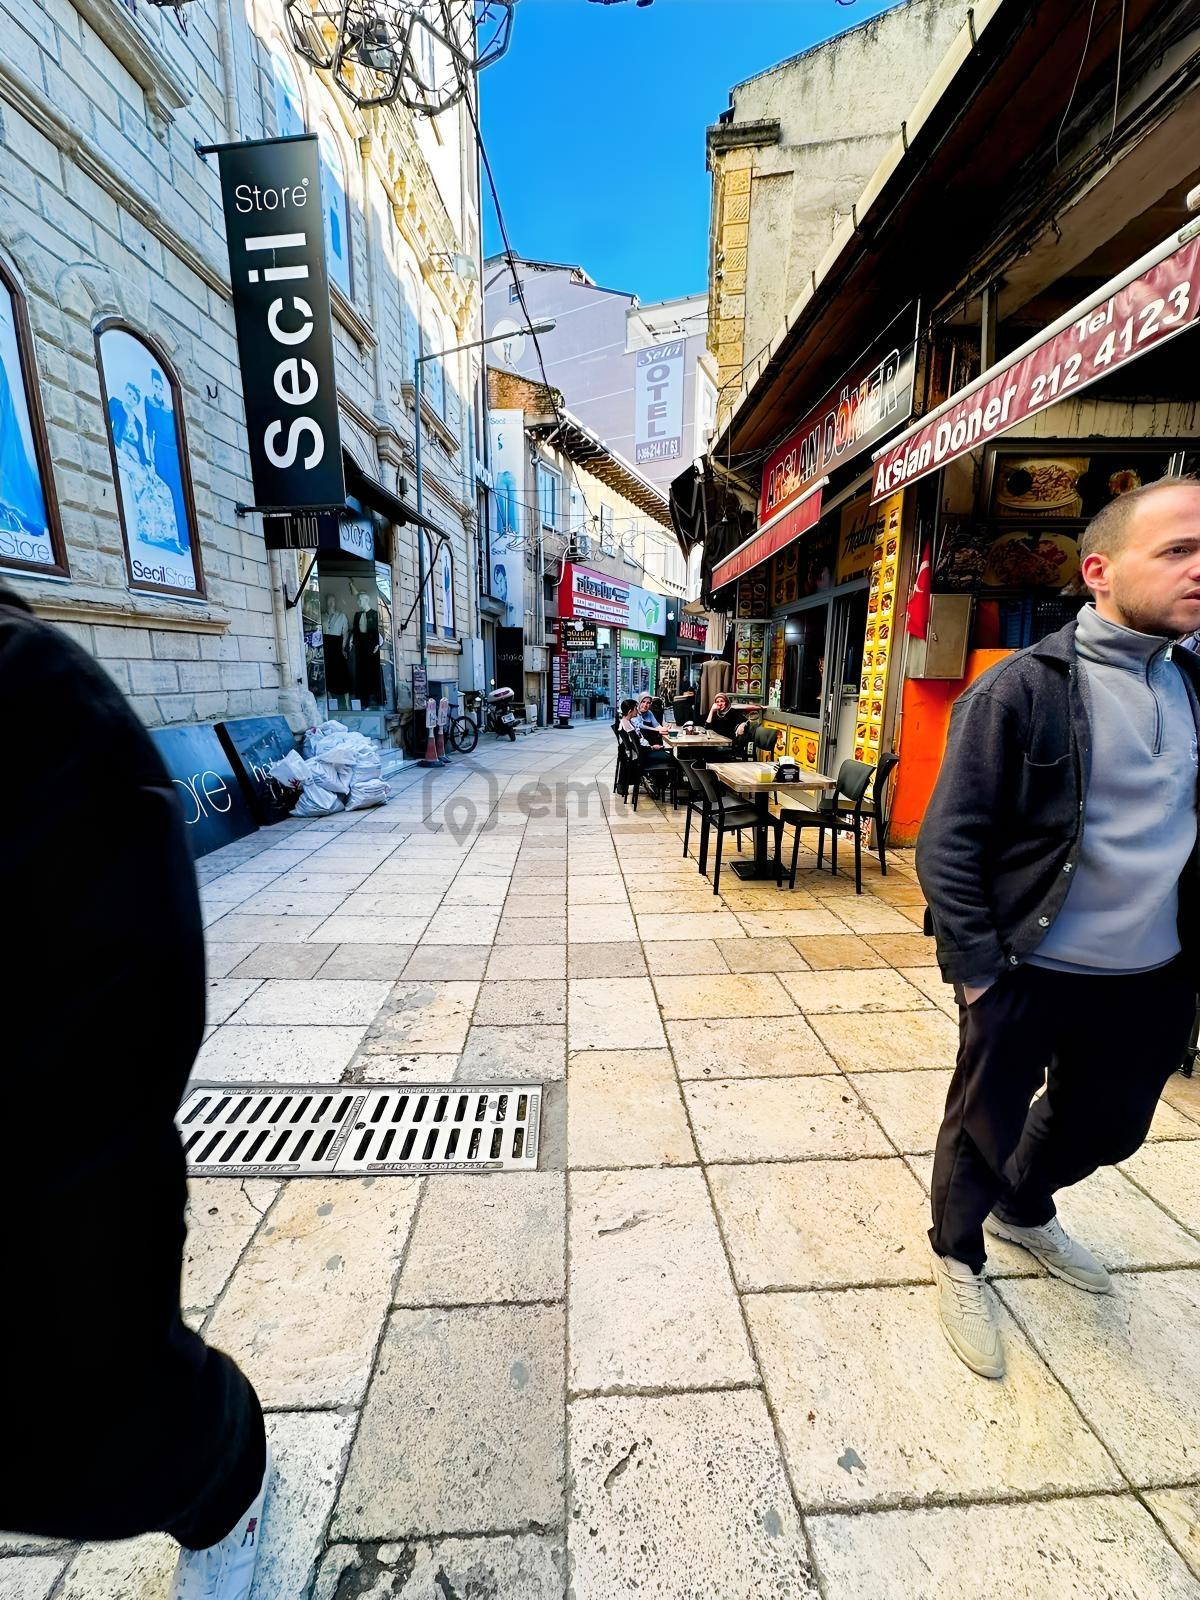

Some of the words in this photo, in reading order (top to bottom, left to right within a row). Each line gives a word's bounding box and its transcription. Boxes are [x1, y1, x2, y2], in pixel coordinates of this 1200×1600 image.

[244, 232, 324, 471] Secil
[638, 344, 680, 367] Selvi
[1076, 297, 1115, 342] Tel
[646, 364, 670, 438] OTEL
[765, 424, 821, 513] ARSLAN
[822, 348, 900, 469] DÖNER
[873, 438, 932, 497] Arslan
[933, 384, 1018, 460] Döner
[1028, 353, 1083, 408] 212
